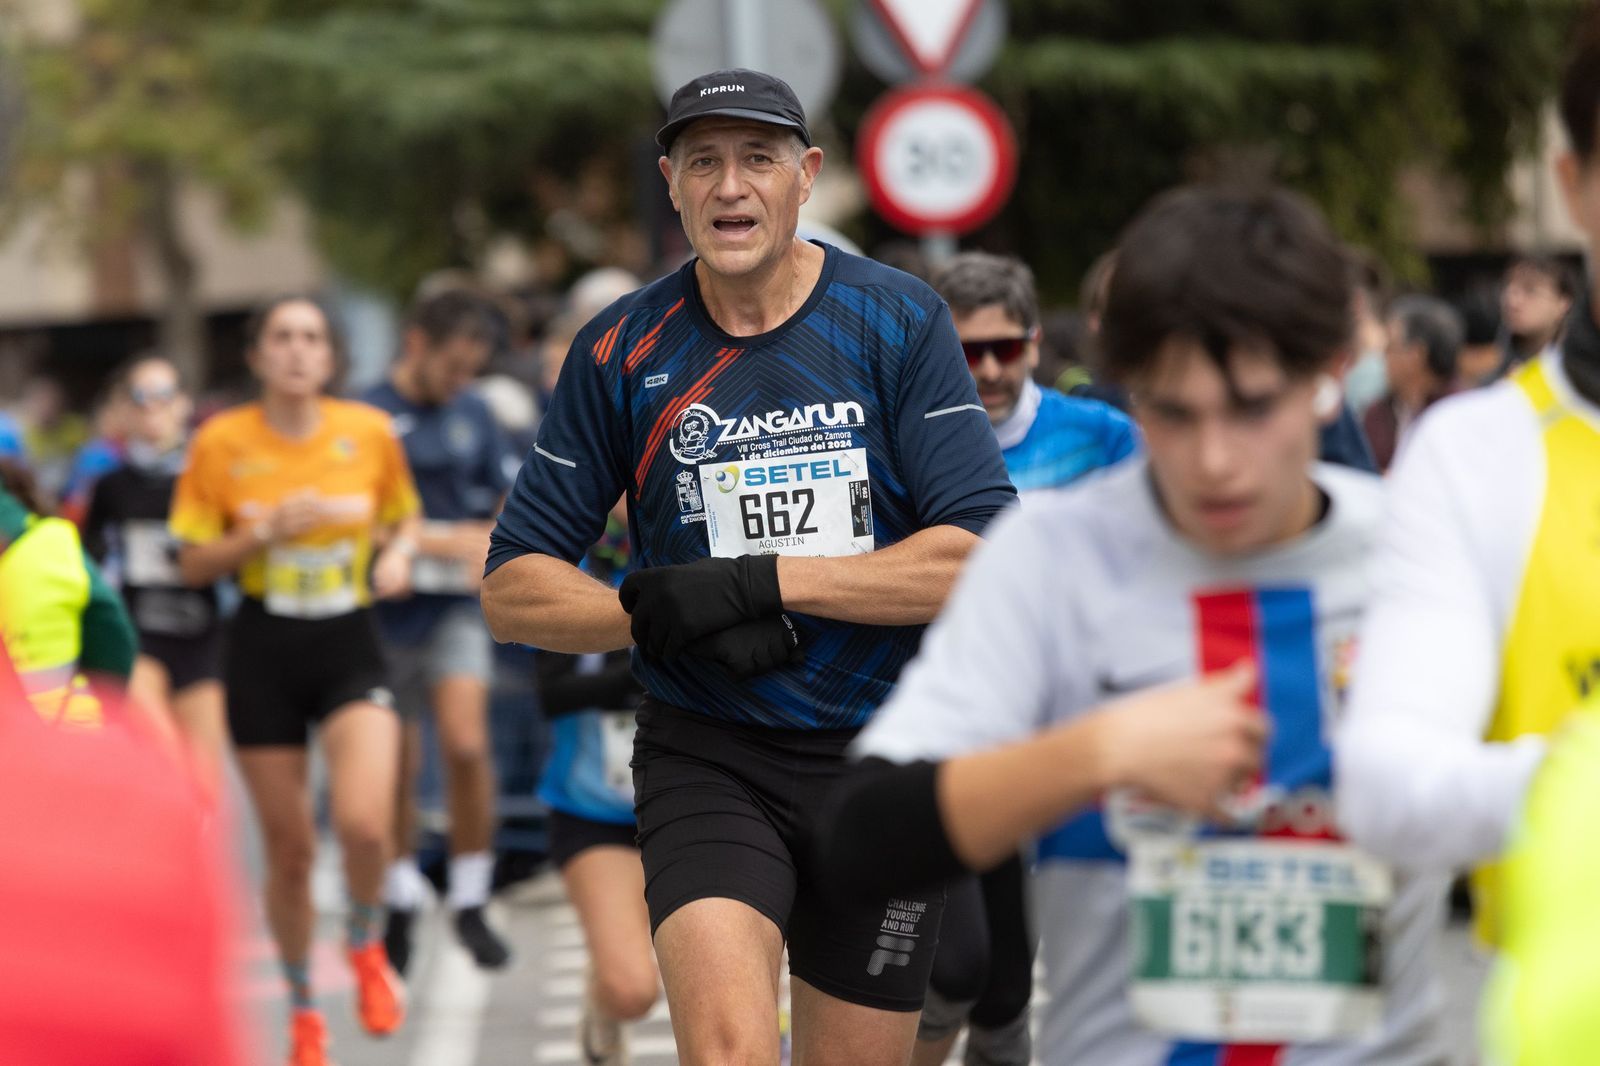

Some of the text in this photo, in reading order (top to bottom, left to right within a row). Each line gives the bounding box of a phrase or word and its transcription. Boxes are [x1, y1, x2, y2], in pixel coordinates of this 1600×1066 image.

[700, 84, 745, 97] KIPRUN
[749, 451, 761, 460] de
[762, 445, 809, 459] diciembre
[811, 442, 826, 451] del
[827, 439, 852, 450] 2024
[750, 441, 771, 452] Cross
[772, 438, 787, 448] Trail
[788, 434, 813, 446] Ciudad
[814, 432, 823, 442] de
[824, 430, 852, 441] Zamora
[744, 459, 852, 487] SETEL
[739, 487, 819, 540] 662
[758, 536, 805, 549] AGUSTIN
[887, 898, 927, 912] CHALLENGE
[886, 908, 921, 923] YOURSELF
[881, 919, 915, 933] AND RUN
[1170, 898, 1325, 980] 6133
